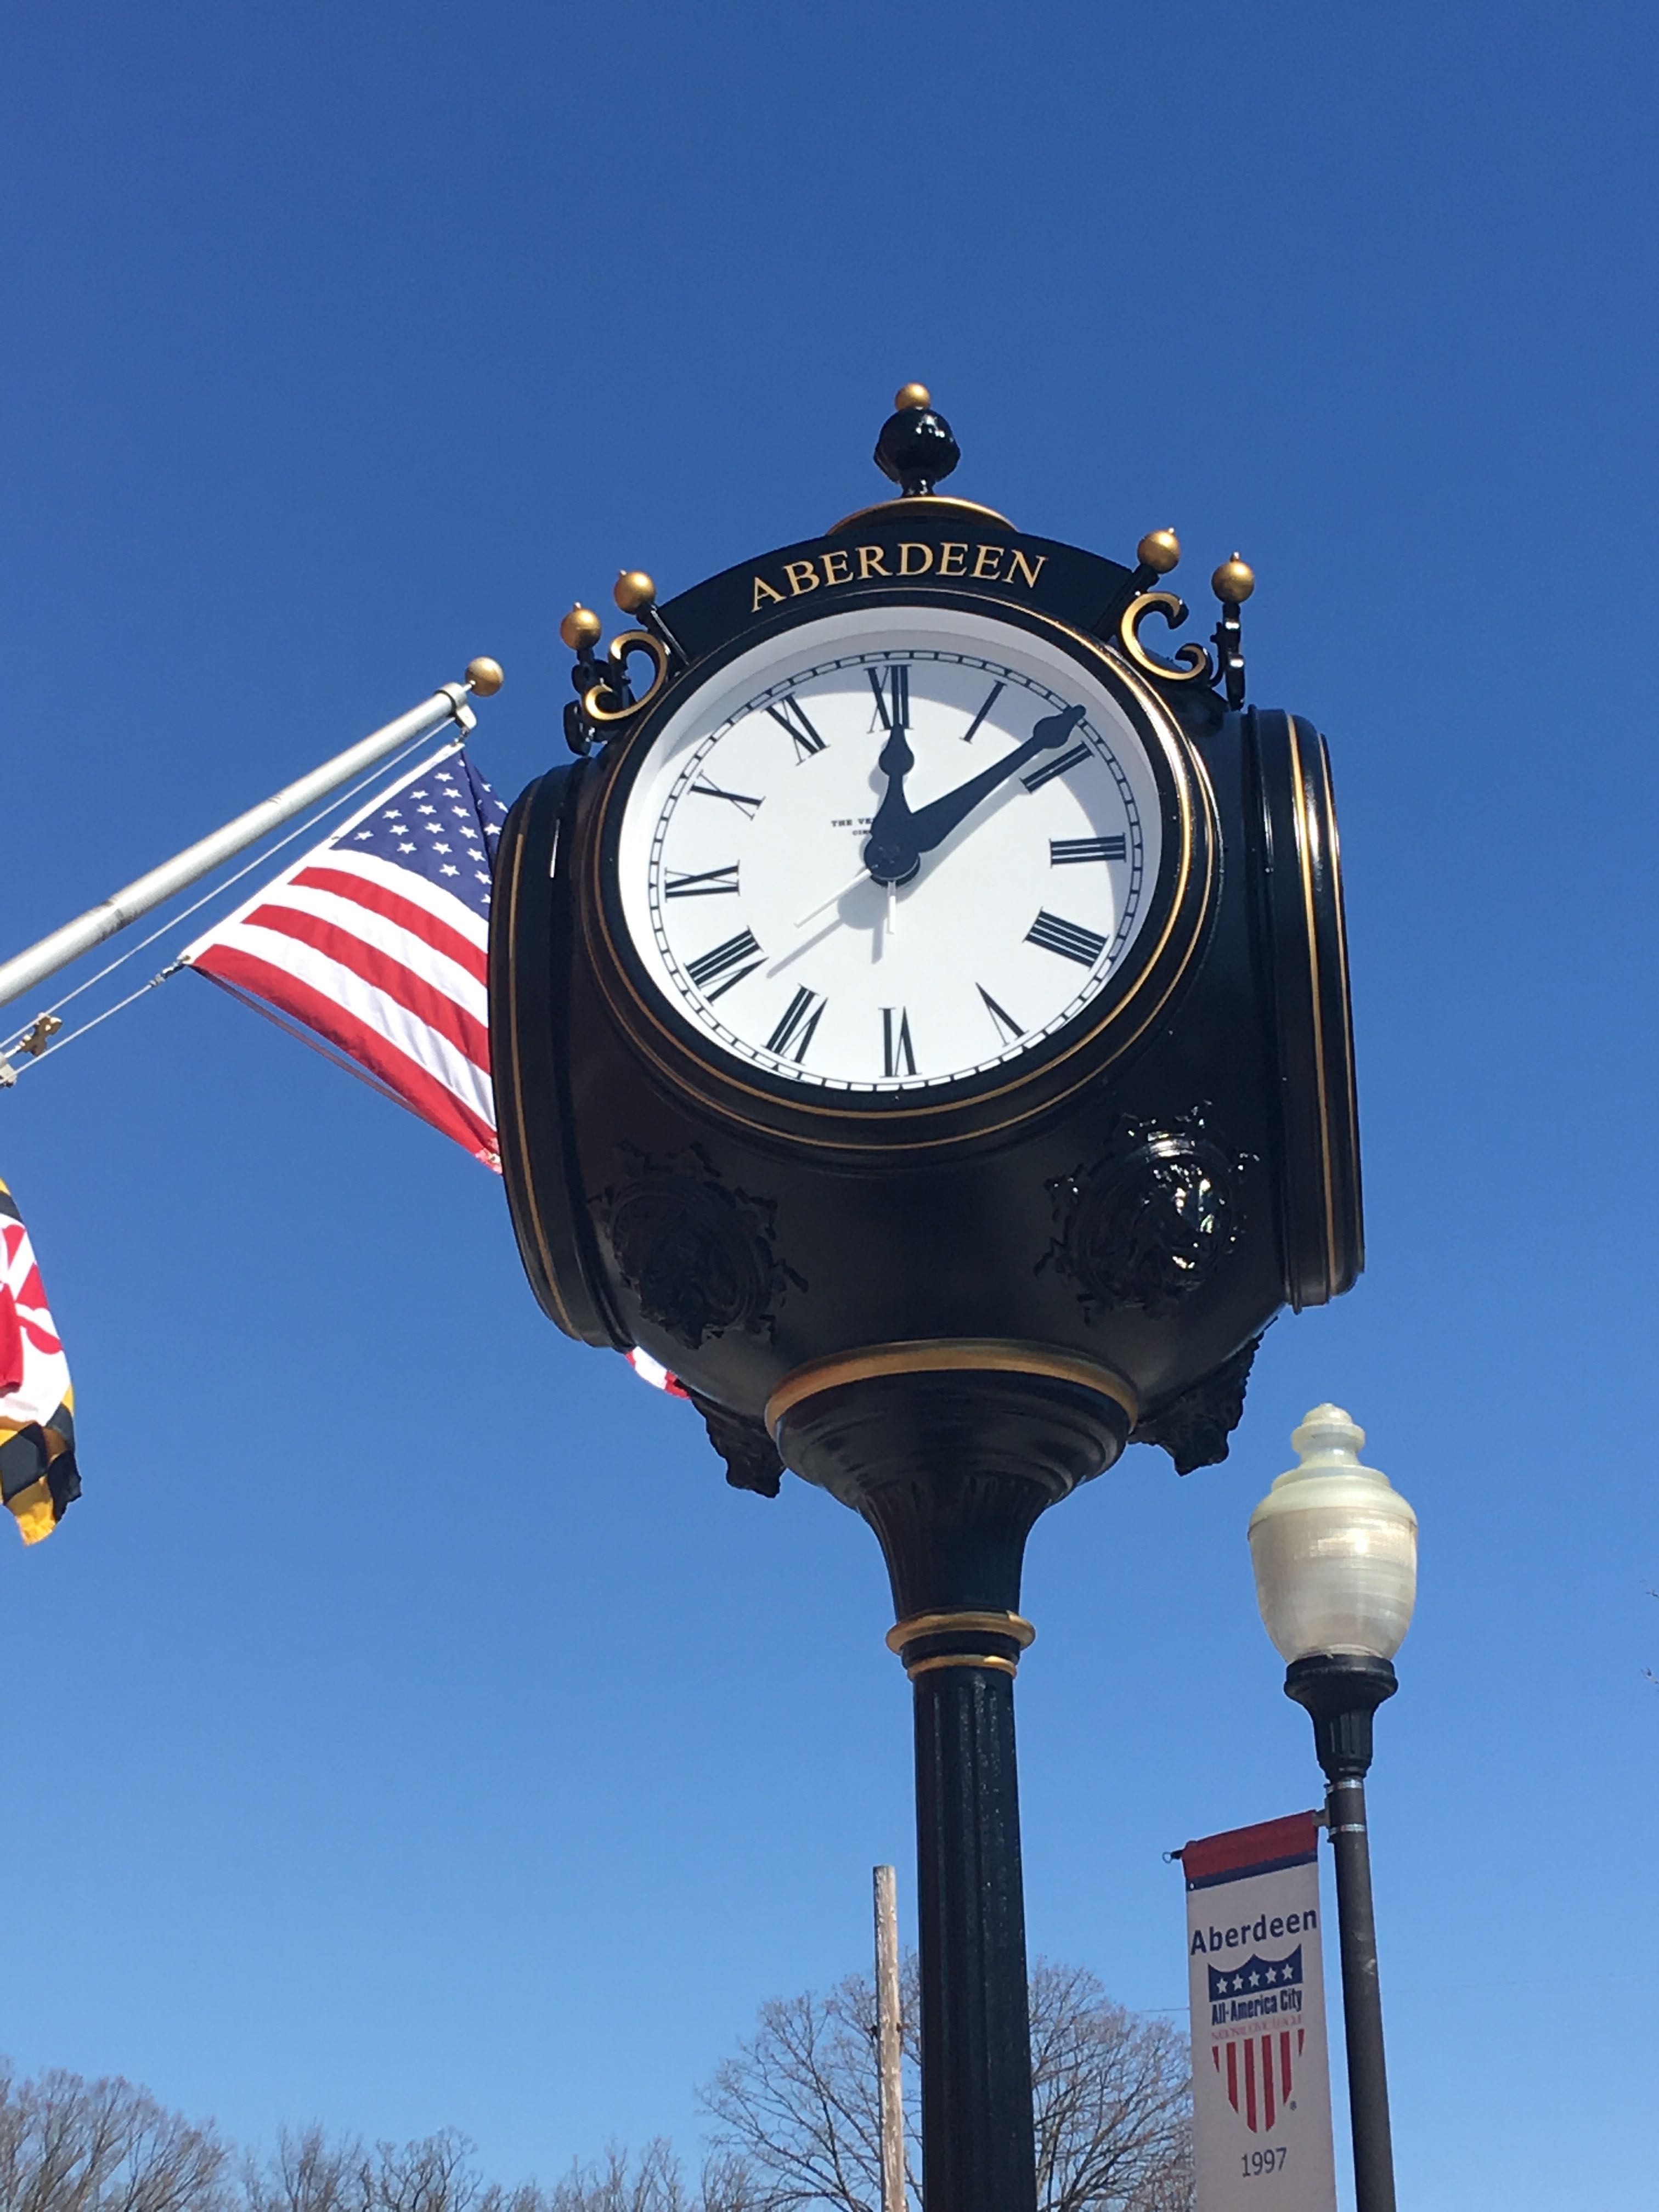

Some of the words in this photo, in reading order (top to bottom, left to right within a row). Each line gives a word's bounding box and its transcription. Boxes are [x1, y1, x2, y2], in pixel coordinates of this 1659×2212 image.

[751, 543, 1048, 612] ABERDEEN
[763, 691, 831, 765] XI
[864, 664, 913, 733] XII
[959, 680, 1007, 744] I
[688, 771, 765, 820] X
[1020, 742, 1093, 793] II
[831, 819, 852, 827] THE
[1049, 832, 1126, 866] III
[665, 859, 741, 901] IX
[684, 926, 769, 1005] VIII
[1023, 907, 1109, 969] IIII
[761, 983, 829, 1065] VII
[879, 1006, 922, 1077] VI
[975, 982, 1030, 1047] V
[1190, 1909, 1317, 1955] Aberdeen
[1212, 1994, 1278, 2025] All-America
[1280, 1988, 1302, 2012] City
[1242, 2147, 1287, 2177] 1997
